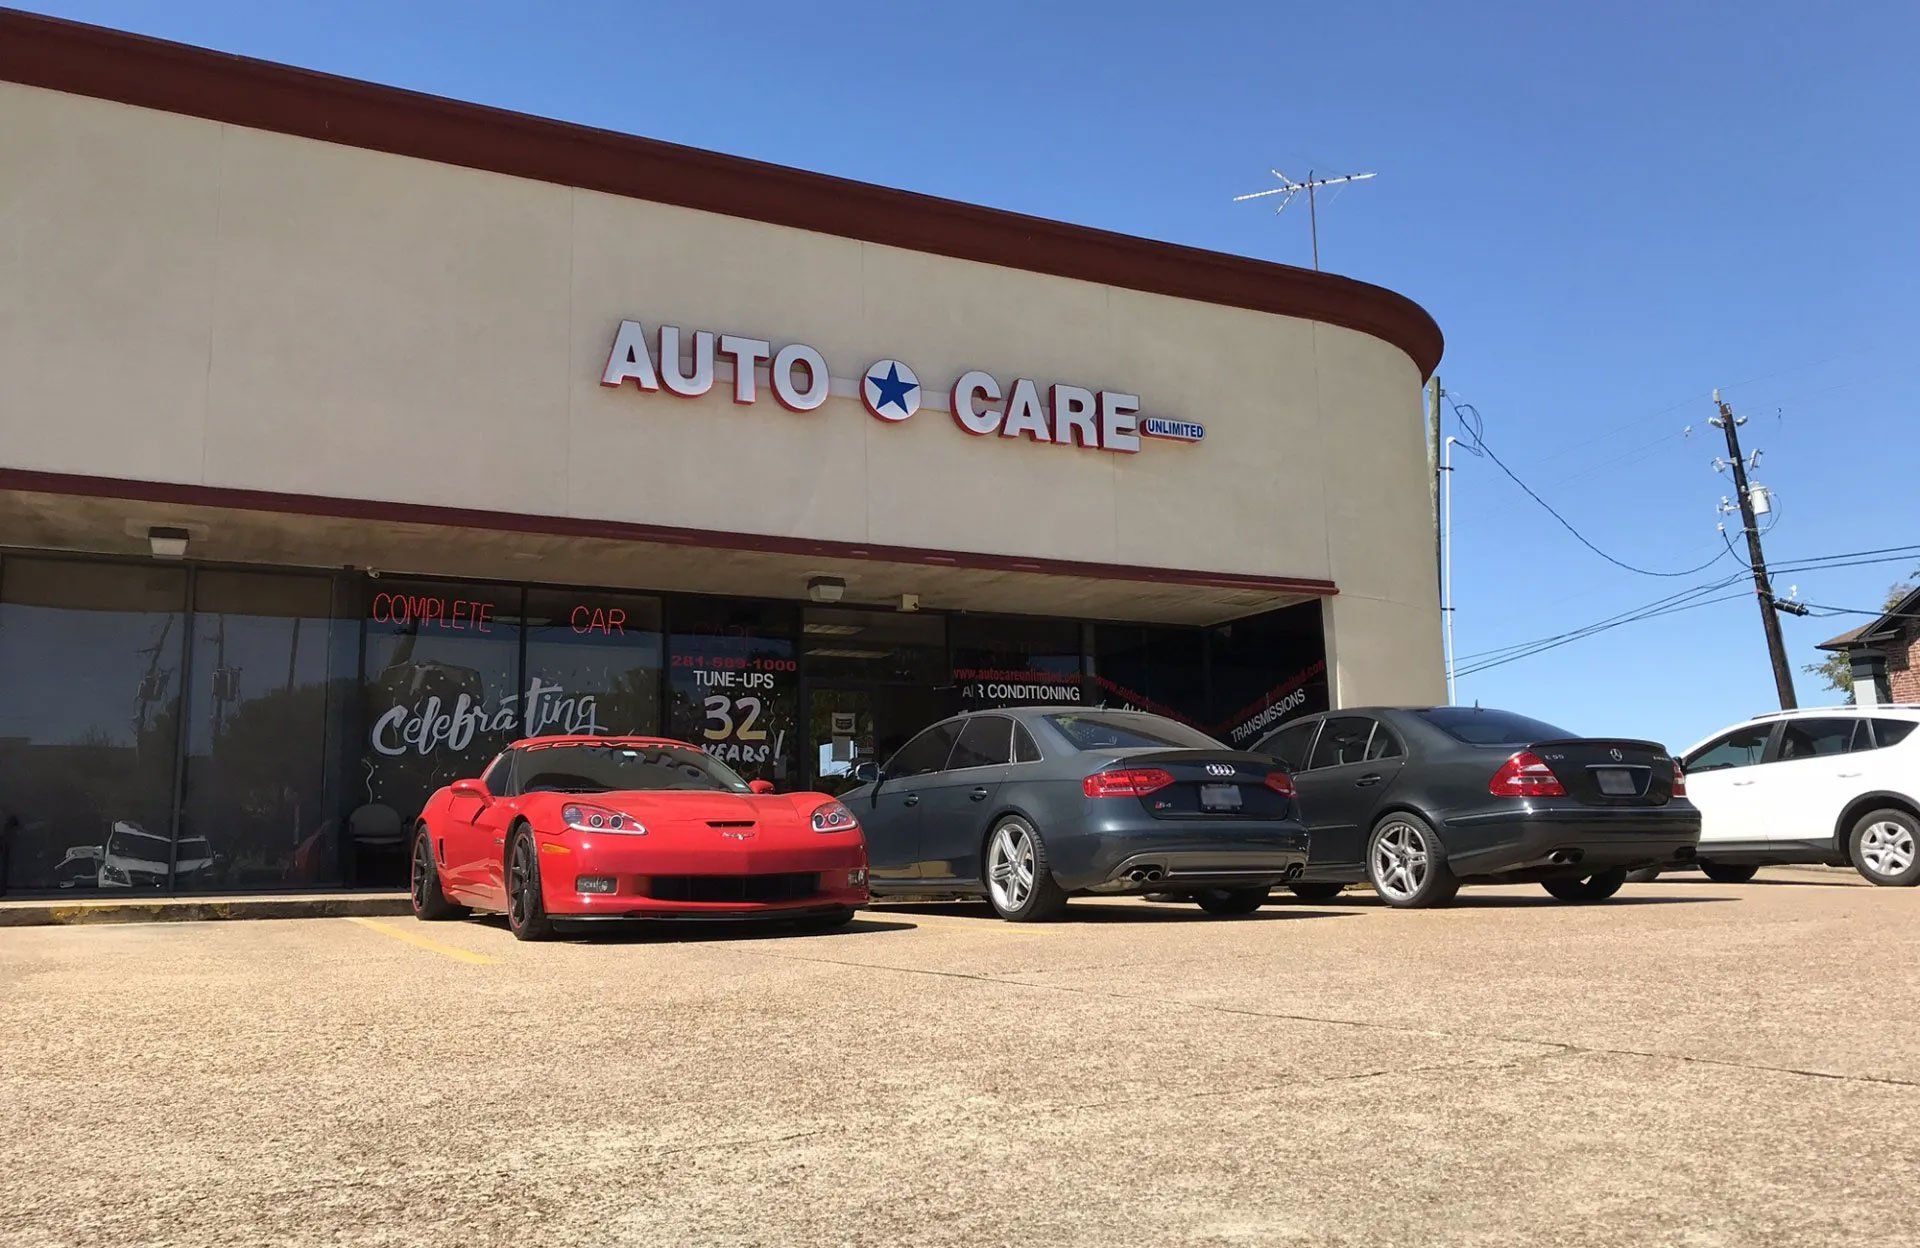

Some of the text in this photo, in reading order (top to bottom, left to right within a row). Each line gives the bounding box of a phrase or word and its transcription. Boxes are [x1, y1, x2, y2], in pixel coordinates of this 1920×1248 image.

[601, 319, 1140, 453] AUTO CARE
[1147, 419, 1204, 438] UNLIMITED
[373, 592, 626, 636] COMPLETE CAR
[693, 669, 774, 689] TUNE-UPS
[987, 684, 1080, 701] CONDITIONING
[371, 677, 608, 756] Celebrating
[703, 695, 767, 740] 32
[1231, 688, 1306, 743] TRANSMISSIONS
